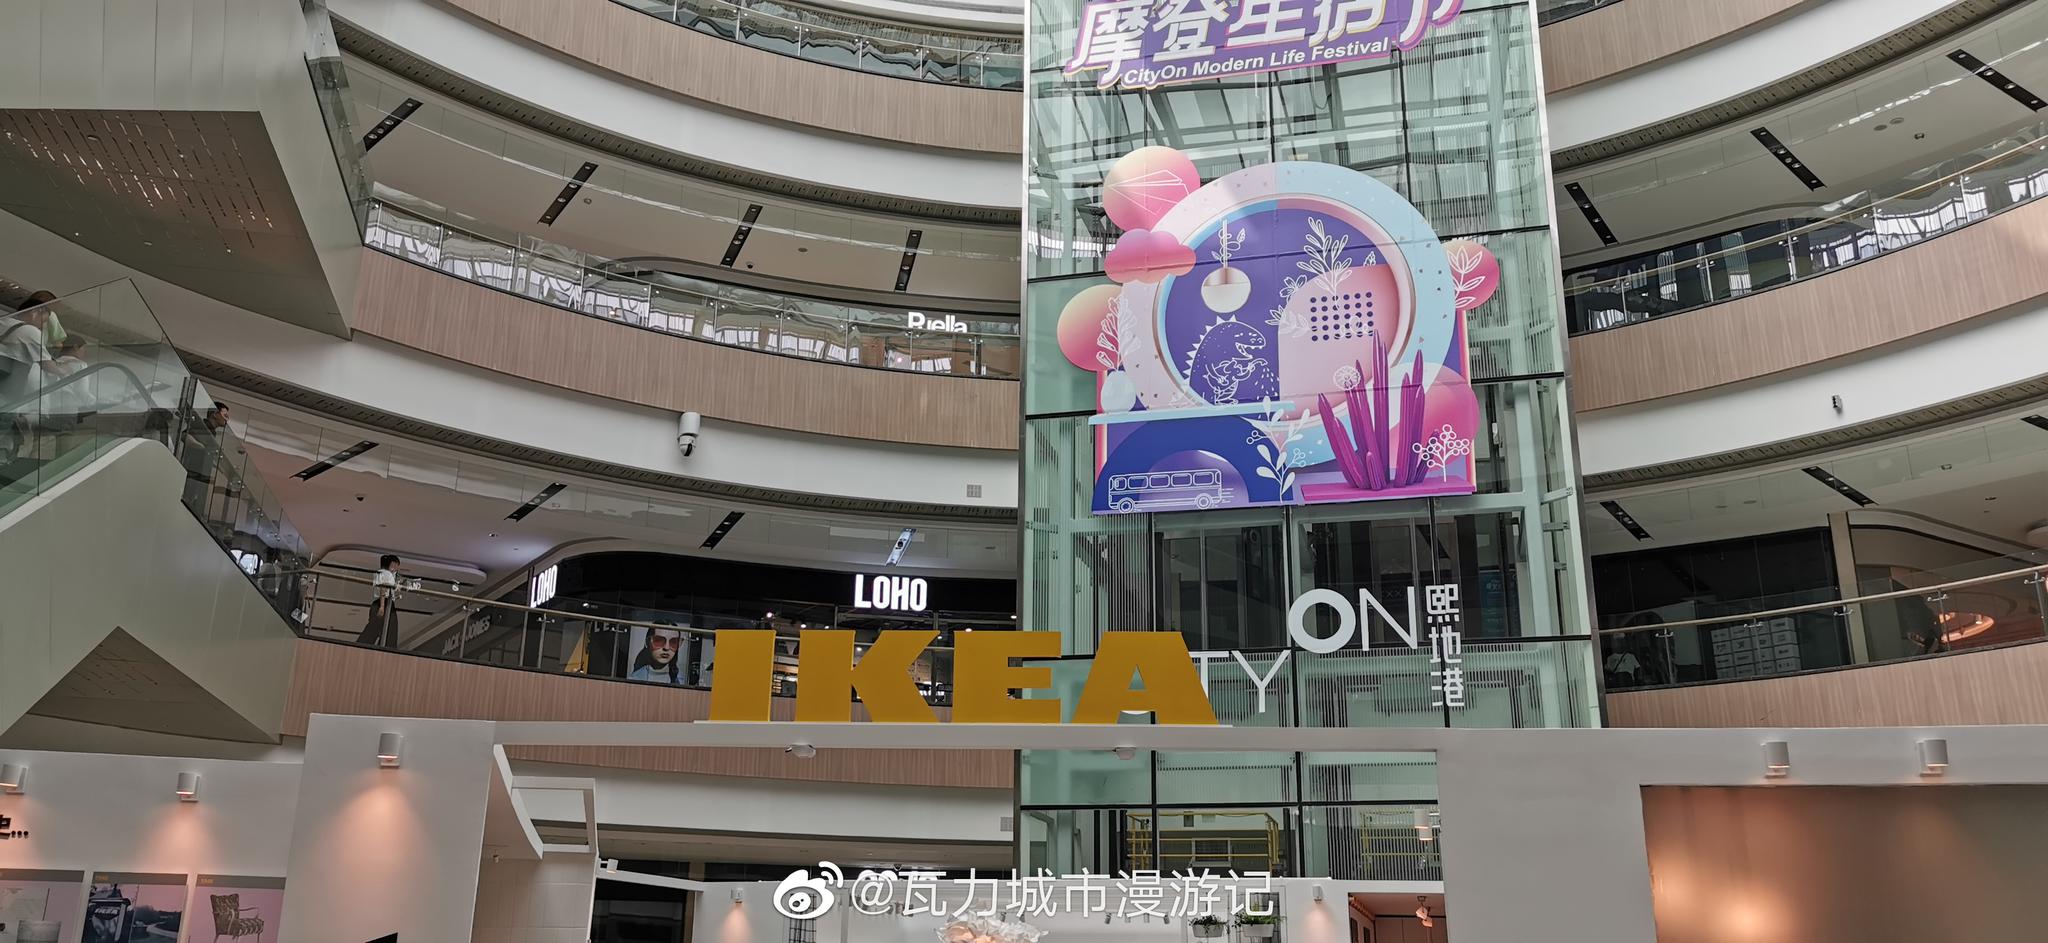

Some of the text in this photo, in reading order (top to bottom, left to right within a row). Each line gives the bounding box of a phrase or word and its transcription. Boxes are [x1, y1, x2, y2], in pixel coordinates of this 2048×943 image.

[1072, 0, 1453, 85] 摩登生活
[1124, 37, 1389, 85] CityOn Modern Life Festival
[531, 564, 558, 608] LOHO
[854, 573, 928, 612] LOHO
[708, 629, 1219, 725] IKEA
[1188, 586, 1418, 713] TY ON
[1426, 583, 1465, 708] 熙地港
